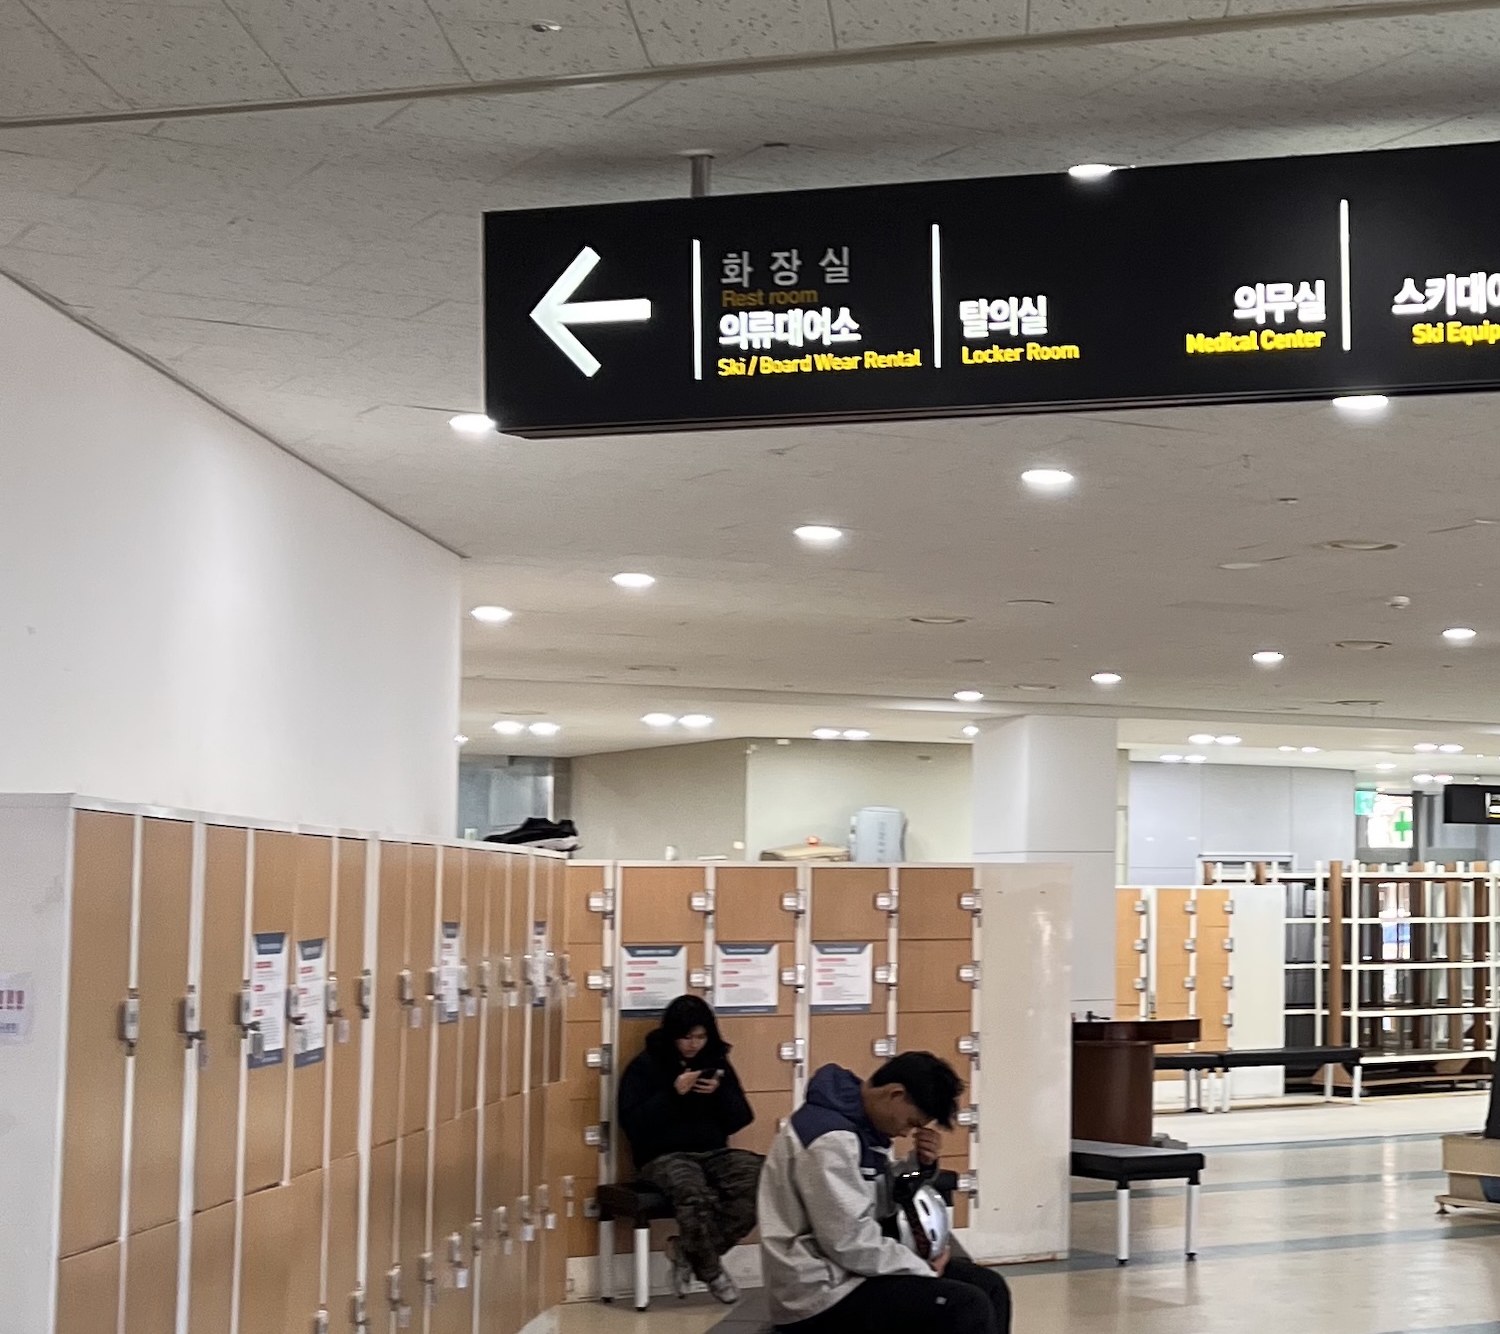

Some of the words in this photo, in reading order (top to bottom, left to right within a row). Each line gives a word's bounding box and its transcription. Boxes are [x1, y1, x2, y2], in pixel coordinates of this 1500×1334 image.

[722, 289, 765, 307] Rest
[769, 289, 818, 305] room
[1233, 279, 1327, 325] 의무실
[718, 306, 862, 351] 의류대여소
[959, 294, 1048, 339] 탈의실
[1185, 330, 1260, 354] Medical
[1260, 328, 1327, 351] Center
[1411, 322, 1445, 345] Ski
[813, 352, 863, 372] Wear
[863, 348, 923, 369] Rental
[961, 344, 1025, 365] Locker
[1026, 341, 1081, 362] Room
